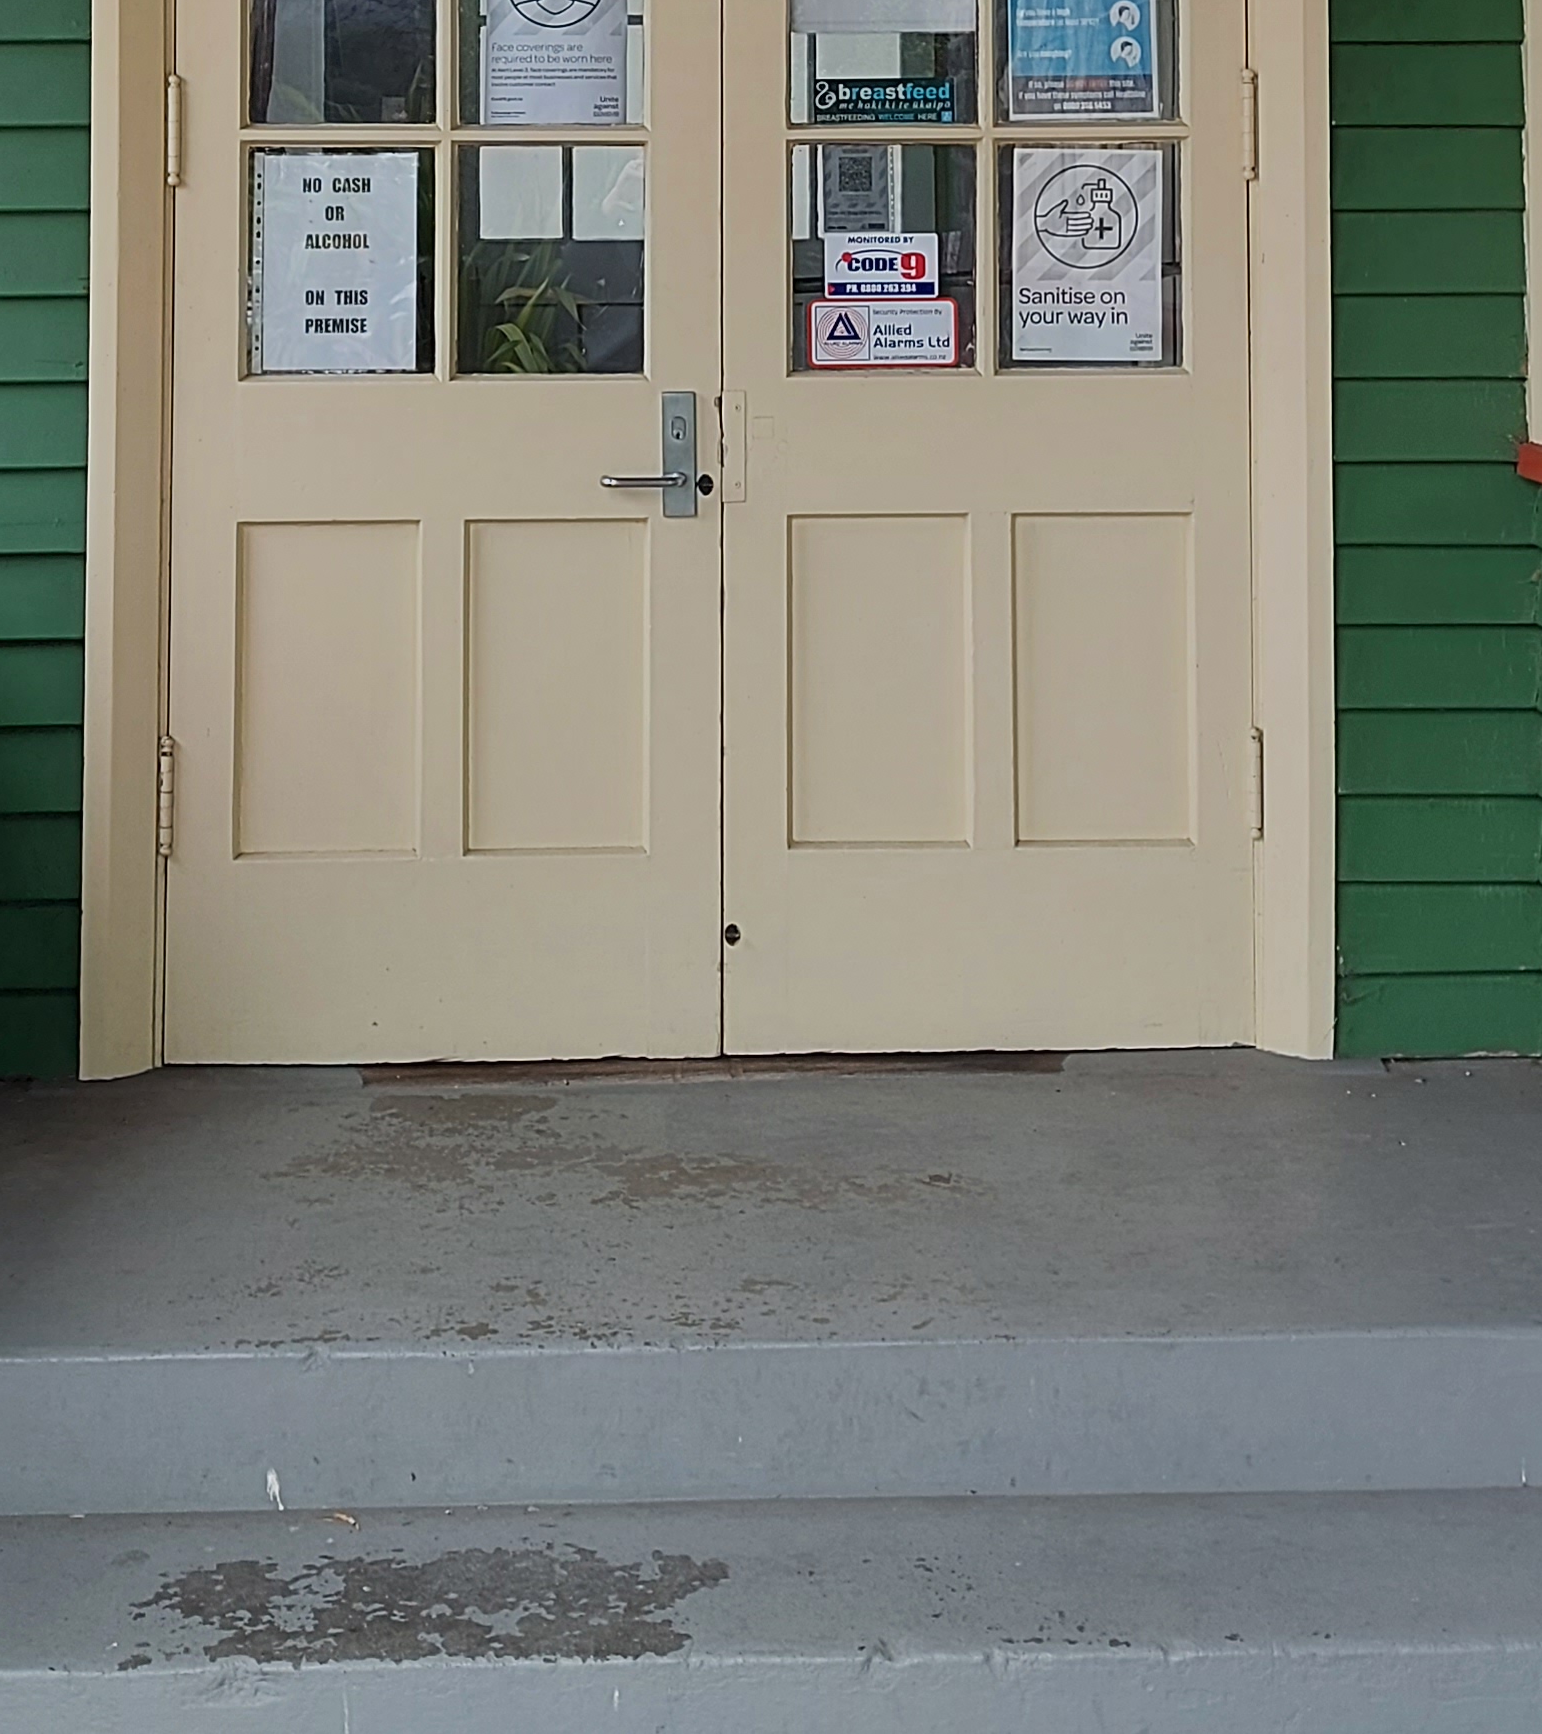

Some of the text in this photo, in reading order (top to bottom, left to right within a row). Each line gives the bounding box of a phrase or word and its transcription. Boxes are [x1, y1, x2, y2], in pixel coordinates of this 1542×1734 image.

[491, 42, 583, 54] Face coverings are
[491, 54, 613, 65] required to be worn here
[839, 82, 950, 100] breastfeed
[816, 113, 876, 122] BREASTFEEDING
[878, 113, 915, 121] WELCOME
[303, 178, 371, 193] NO CASH
[325, 206, 345, 221] OR
[305, 234, 370, 249] ALCOHOL
[847, 236, 915, 244] MONITORED BY
[860, 284, 882, 293] 0800
[1019, 287, 1126, 305] Sanitise on
[305, 290, 369, 306] ON THIS
[1019, 307, 1129, 329] your way in
[305, 318, 368, 334] PREMISE
[873, 323, 912, 336] Allied
[873, 336, 951, 349] Alarms Ltd
